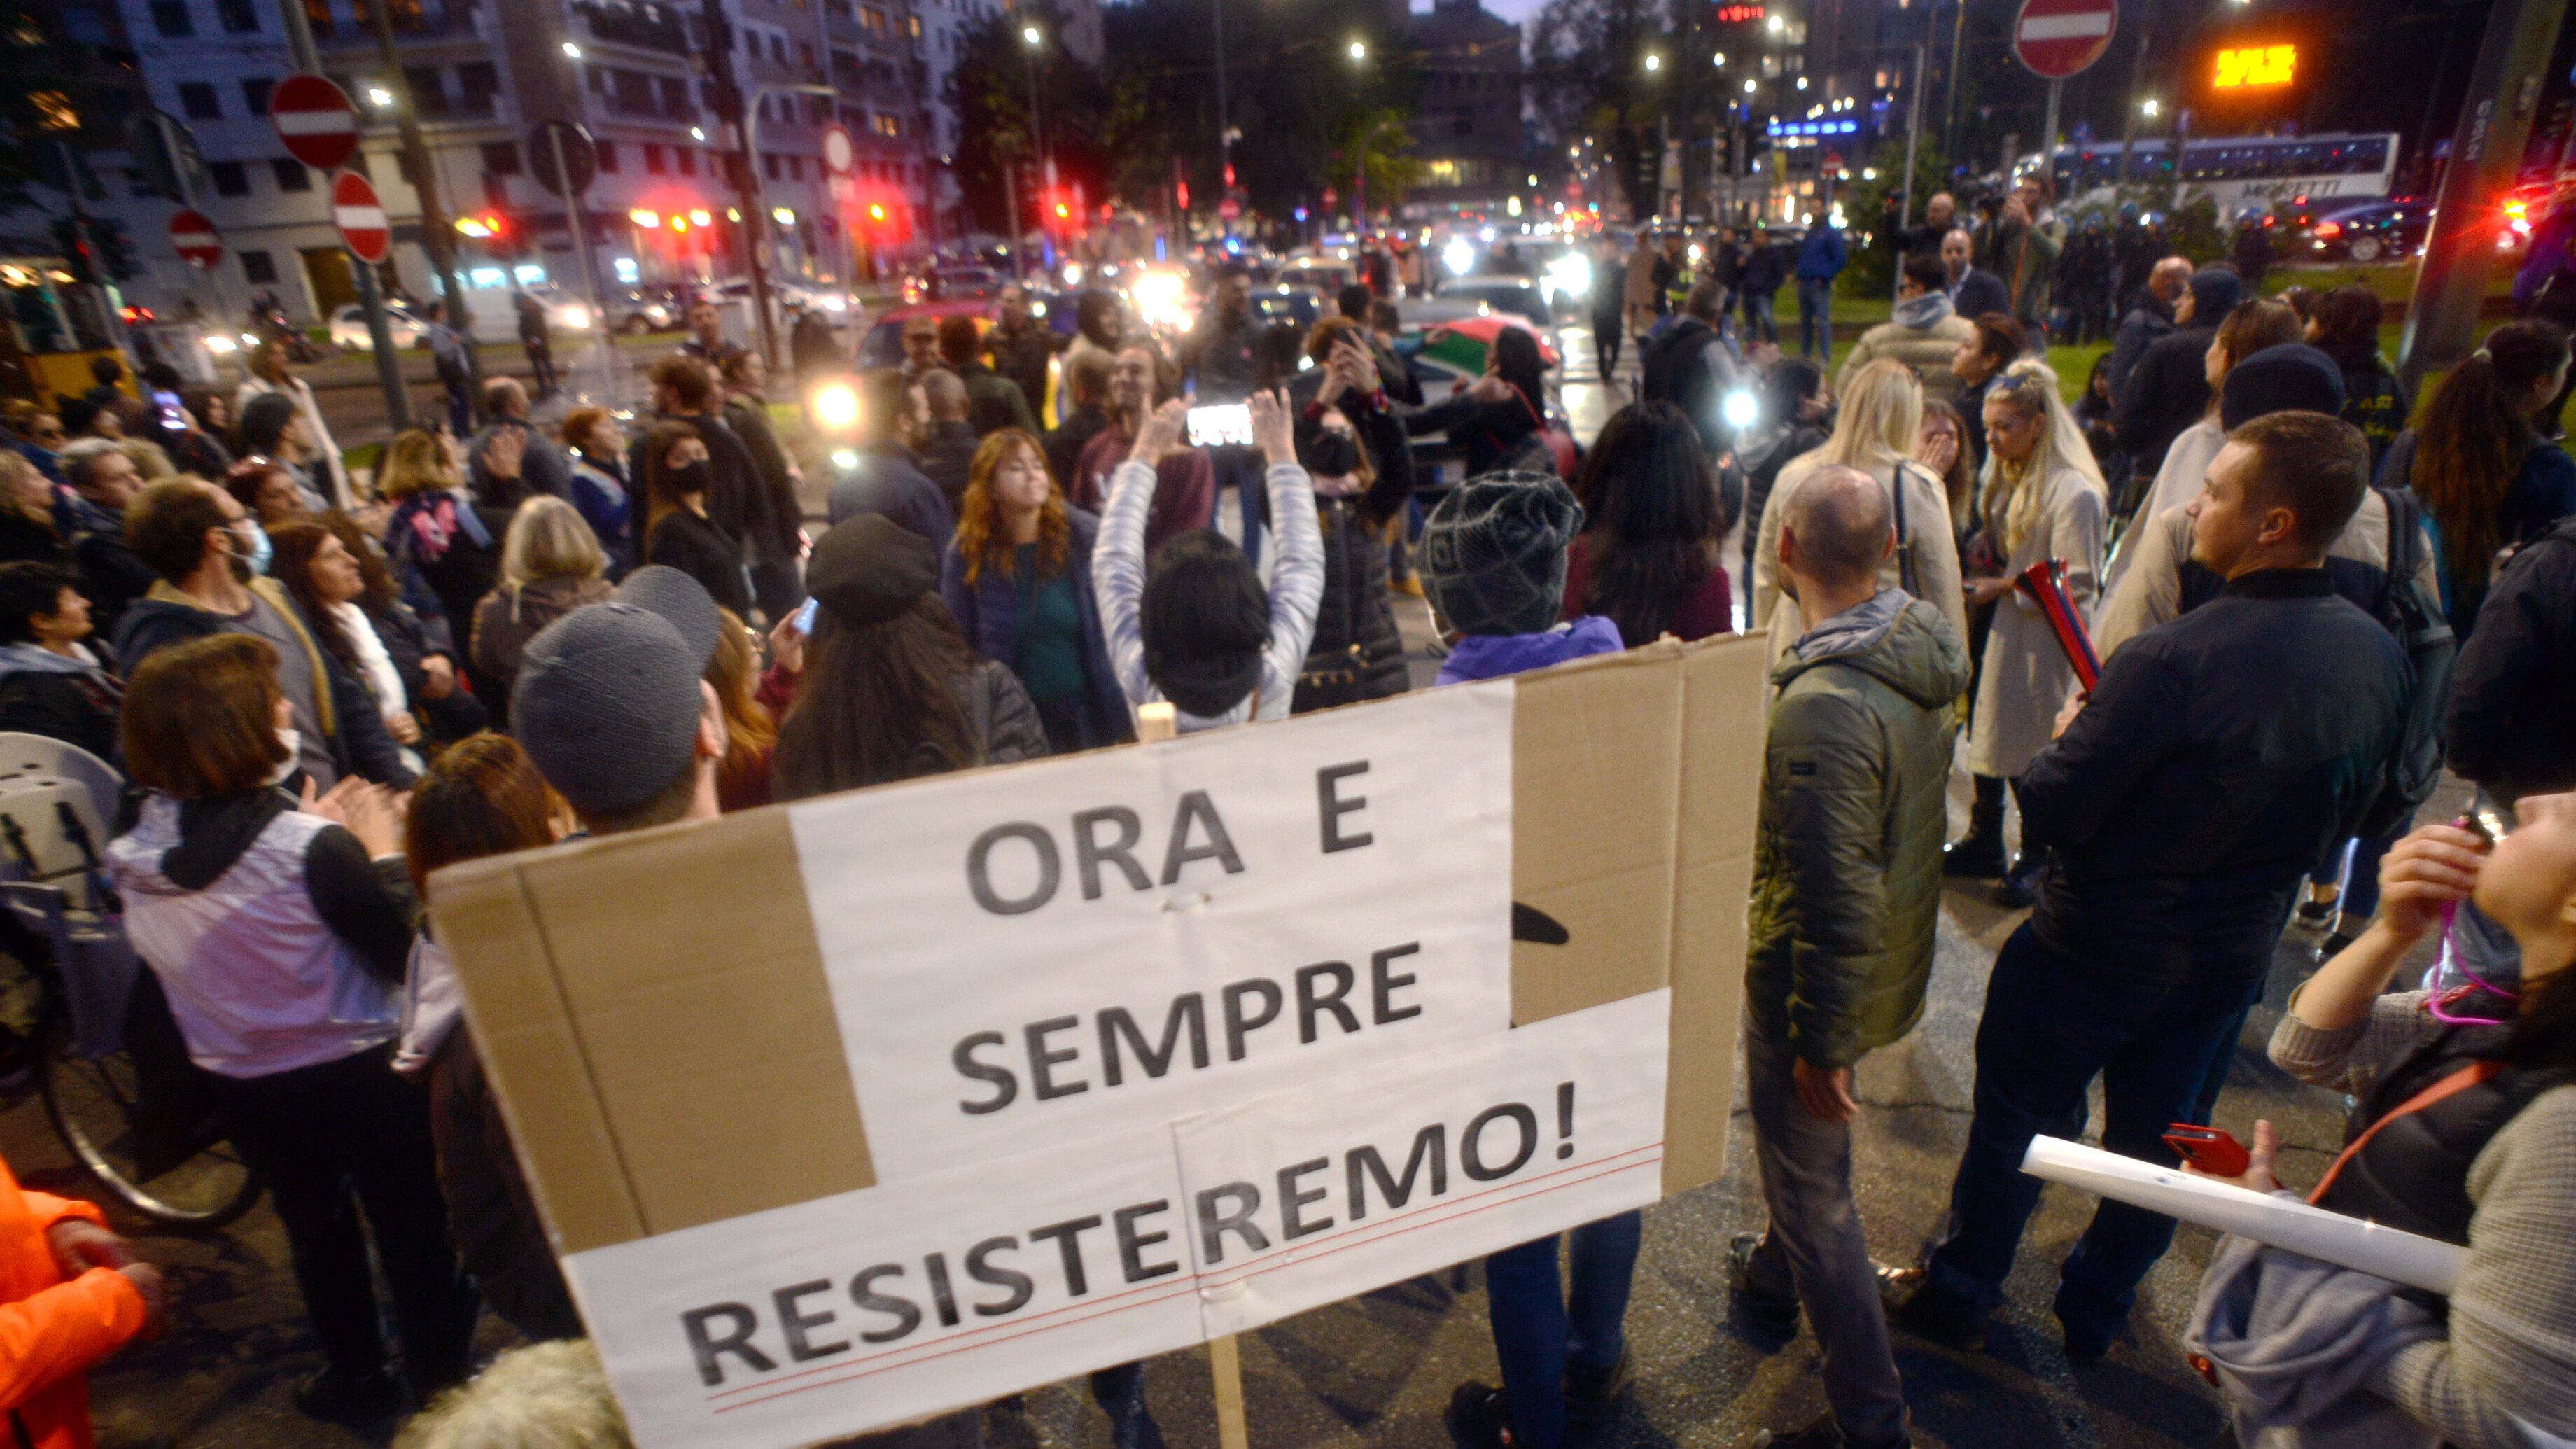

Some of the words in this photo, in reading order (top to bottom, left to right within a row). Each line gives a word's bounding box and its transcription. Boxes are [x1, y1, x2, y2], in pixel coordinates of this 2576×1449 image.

[967, 791, 1245, 916] ORA
[1317, 760, 1373, 855] E
[953, 942, 1422, 1115] SEMPRE
[682, 1082, 1574, 1387] RESISTEREMO!
